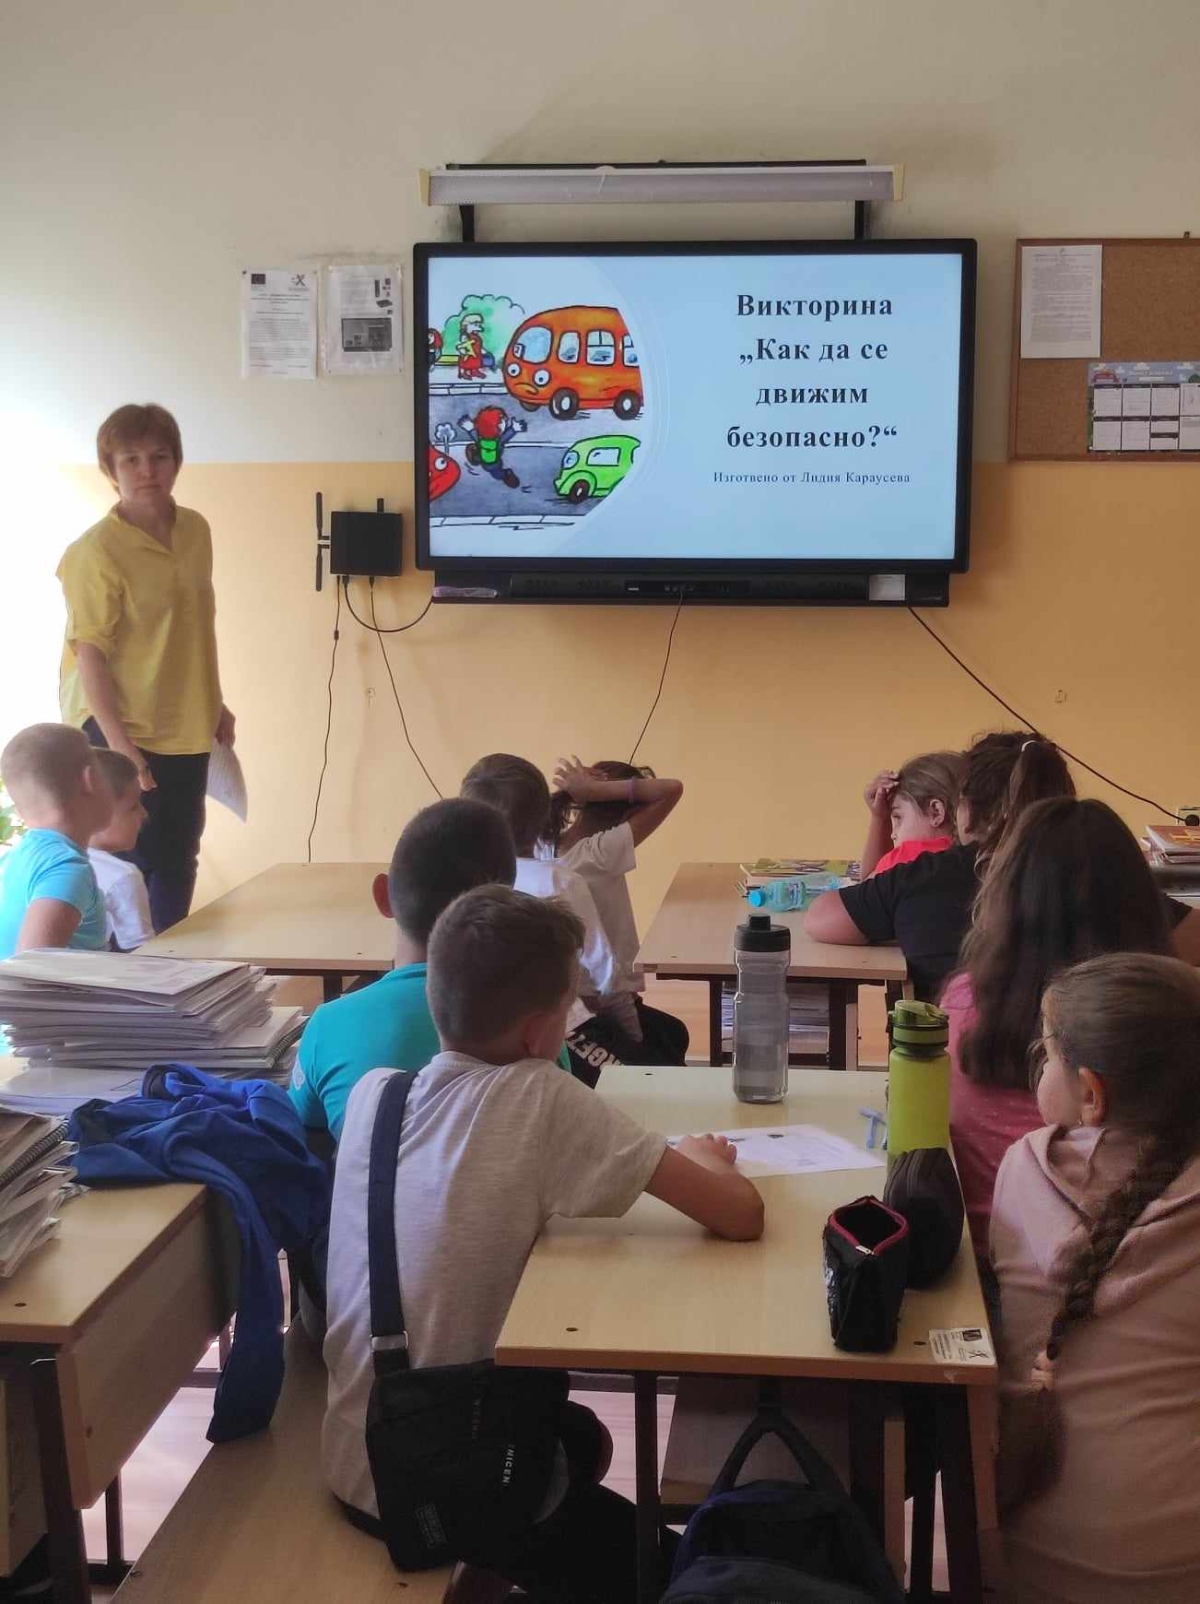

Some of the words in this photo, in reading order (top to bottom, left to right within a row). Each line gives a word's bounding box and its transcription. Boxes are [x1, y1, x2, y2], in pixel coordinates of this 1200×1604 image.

[737, 294, 893, 322] Викторина
[739, 338, 810, 364] „Как
[818, 344, 851, 363] да
[860, 343, 889, 360] се
[755, 387, 869, 407] движим
[727, 425, 898, 449] безопасно?“
[713, 471, 779, 484] Изготвено
[783, 474, 796, 484] от
[800, 471, 841, 484] Лидия
